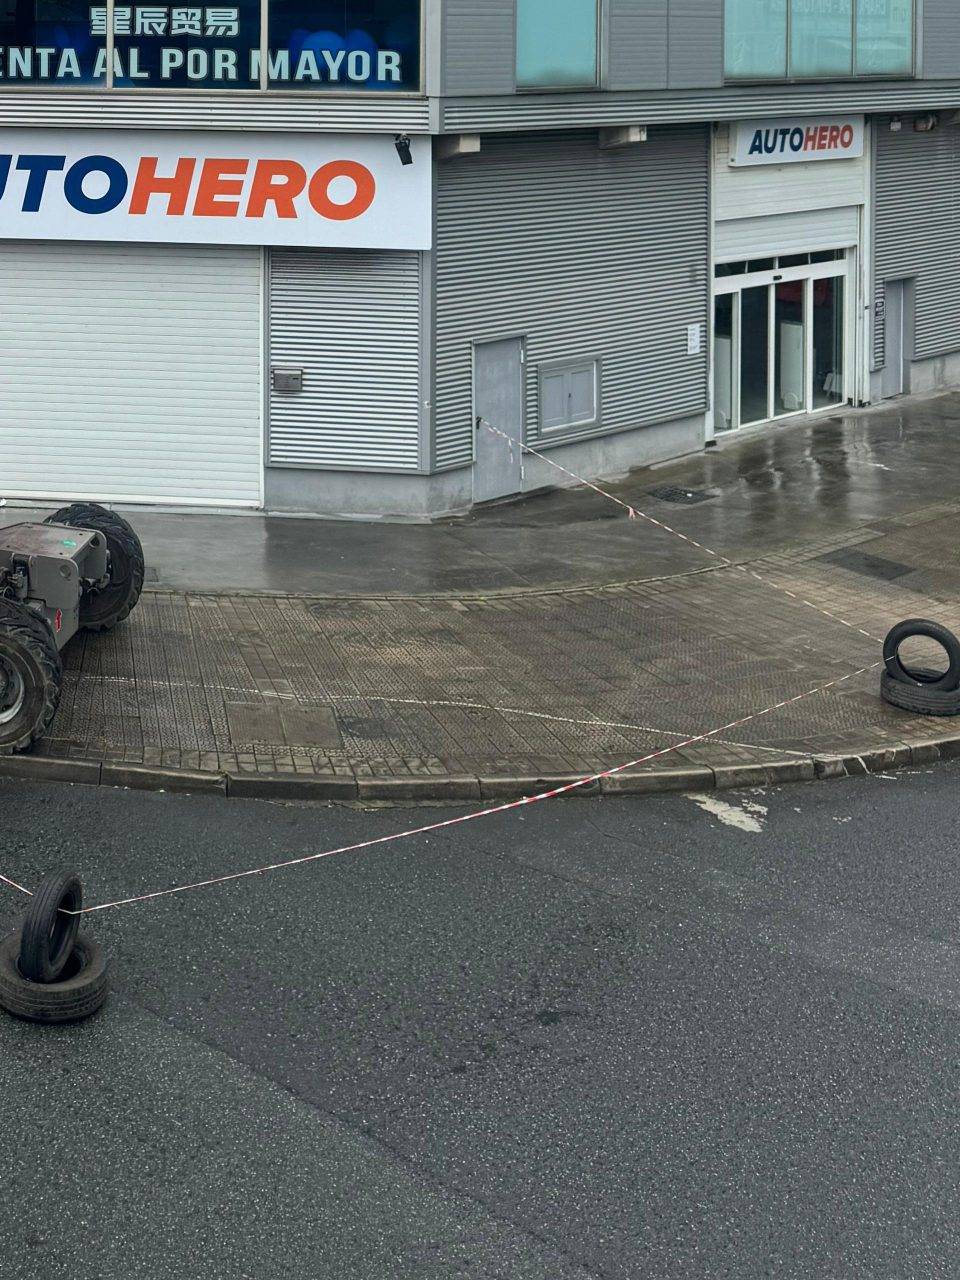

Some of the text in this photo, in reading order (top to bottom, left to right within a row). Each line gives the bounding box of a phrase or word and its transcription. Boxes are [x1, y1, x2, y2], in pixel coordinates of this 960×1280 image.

[90, 6, 240, 37] 星辰贸易
[94, 47, 149, 78] AL
[161, 48, 237, 80] POR
[251, 49, 401, 81] MAYOR
[748, 124, 854, 155] AUTOHERO
